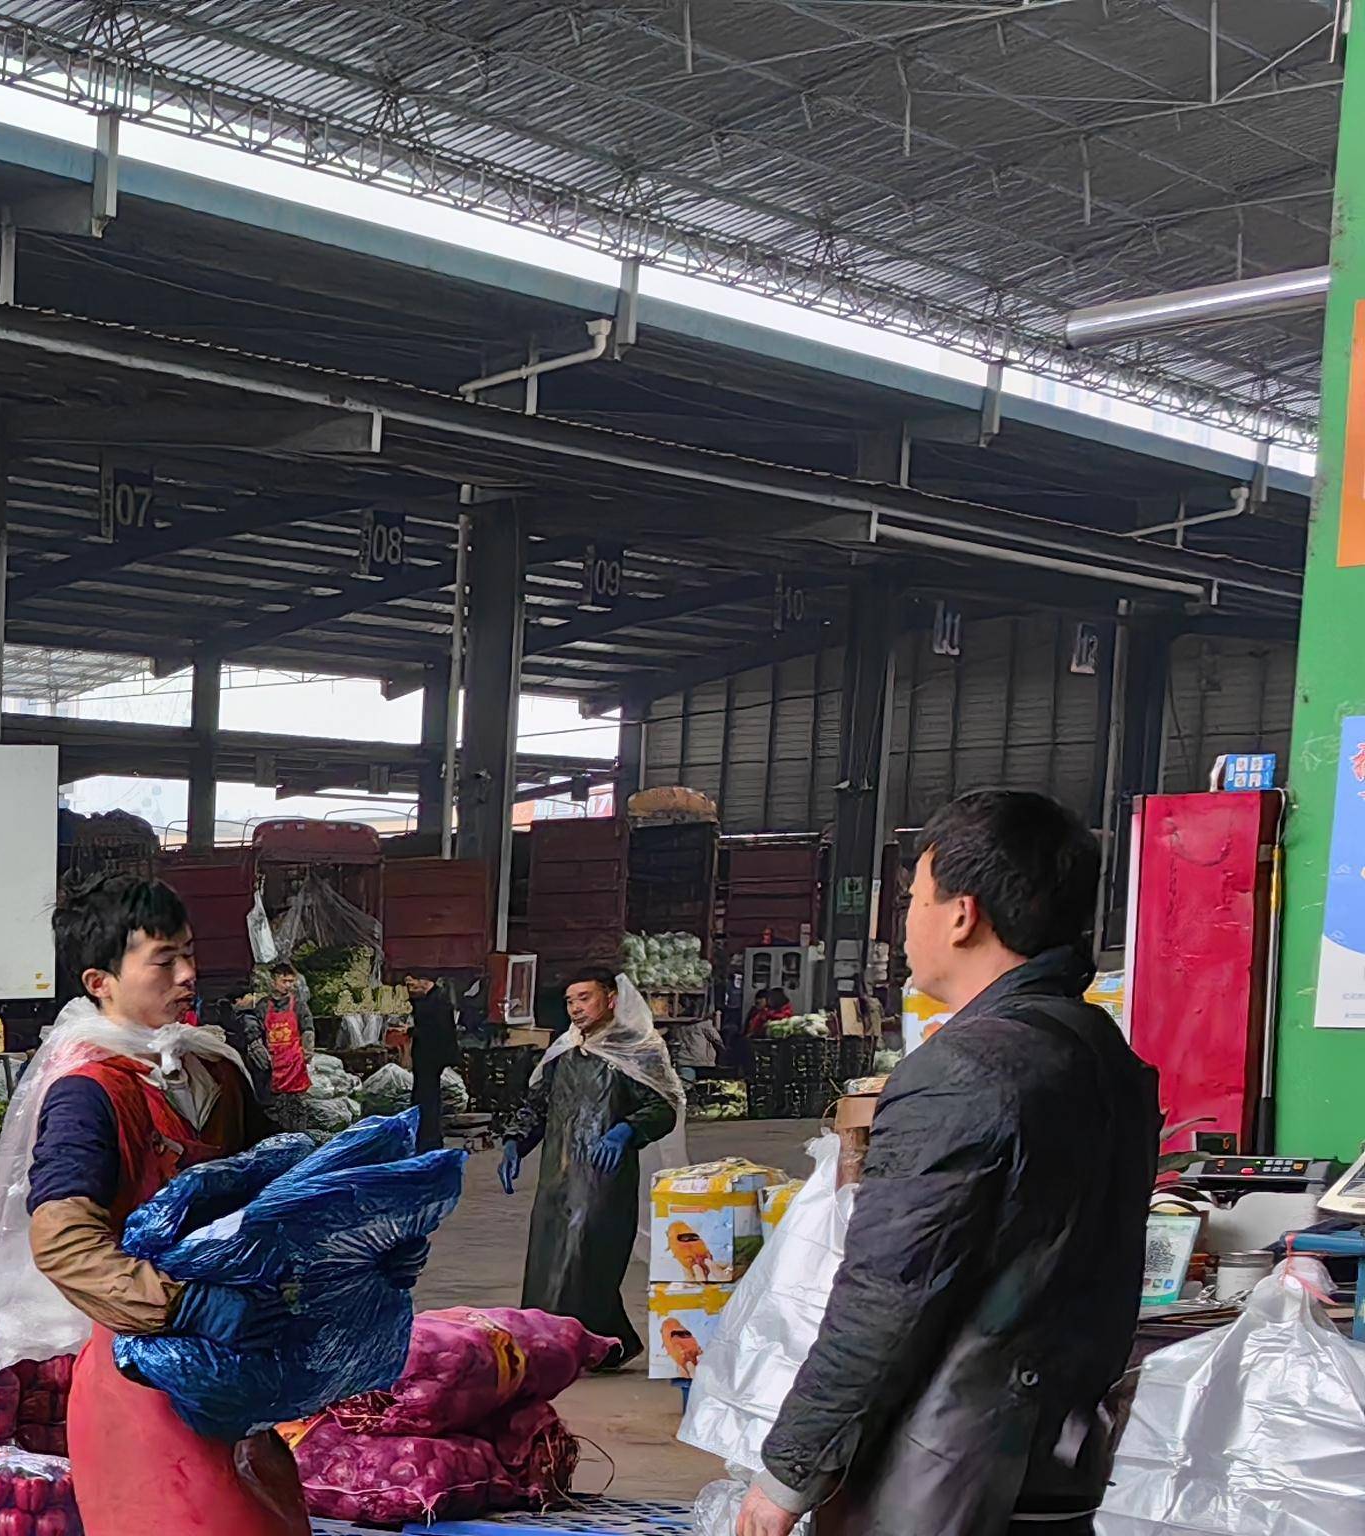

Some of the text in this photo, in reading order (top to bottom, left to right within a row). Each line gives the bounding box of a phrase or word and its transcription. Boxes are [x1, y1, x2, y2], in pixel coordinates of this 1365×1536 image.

[115, 483, 153, 527] 07
[372, 524, 402, 565] 08
[595, 560, 620, 597] 09
